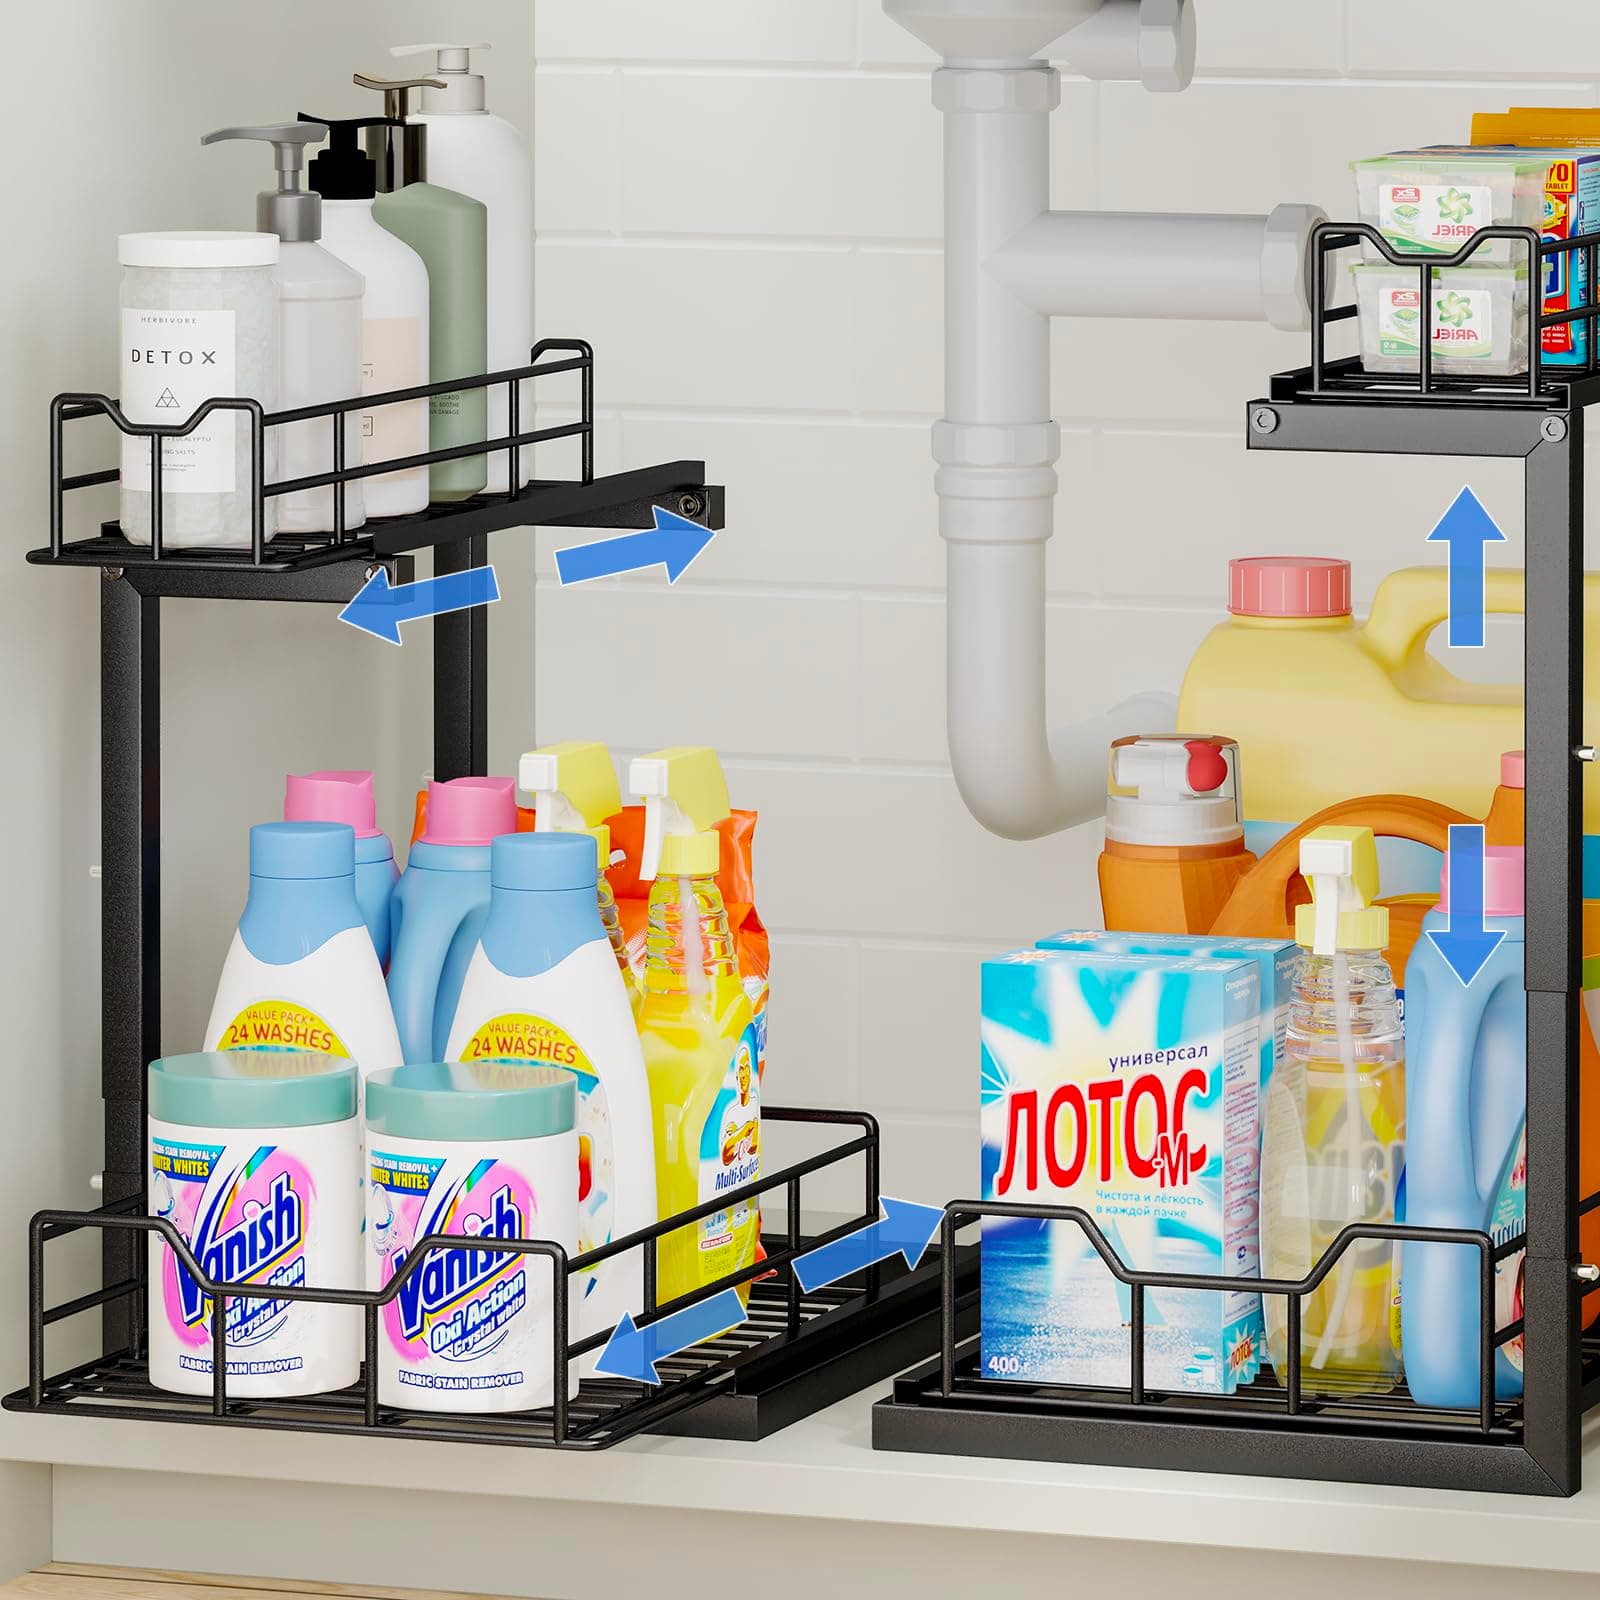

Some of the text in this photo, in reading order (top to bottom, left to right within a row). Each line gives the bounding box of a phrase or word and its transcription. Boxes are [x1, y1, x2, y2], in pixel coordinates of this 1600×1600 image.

[141, 316, 198, 325] HERBIVORE
[131, 348, 216, 365] DETOX
[246, 1009, 277, 1021] VALUE
[229, 1022, 335, 1051] 24 WASHES
[488, 1023, 521, 1034] VALUE
[471, 1035, 578, 1064] 24 WASHES
[1108, 1044, 1209, 1073] универсал
[179, 1148, 211, 1161] REMOVAL
[173, 1158, 209, 1177] WHITES
[398, 1160, 431, 1175] REMOVAL
[392, 1171, 429, 1190] WHITES
[1095, 1188, 1205, 1207] Чистота и лёгкость
[1095, 1203, 1188, 1219] в каждой пачке
[176, 1162, 301, 1322] Vanish
[393, 1178, 520, 1336] Vanish
[432, 1272, 524, 1352] Oxi Action
[180, 1357, 213, 1373] FABRIC
[250, 1360, 303, 1376] REMOVER
[988, 1355, 1020, 1374] 400
[399, 1371, 523, 1390] FABRIC STAIN REMOVER
